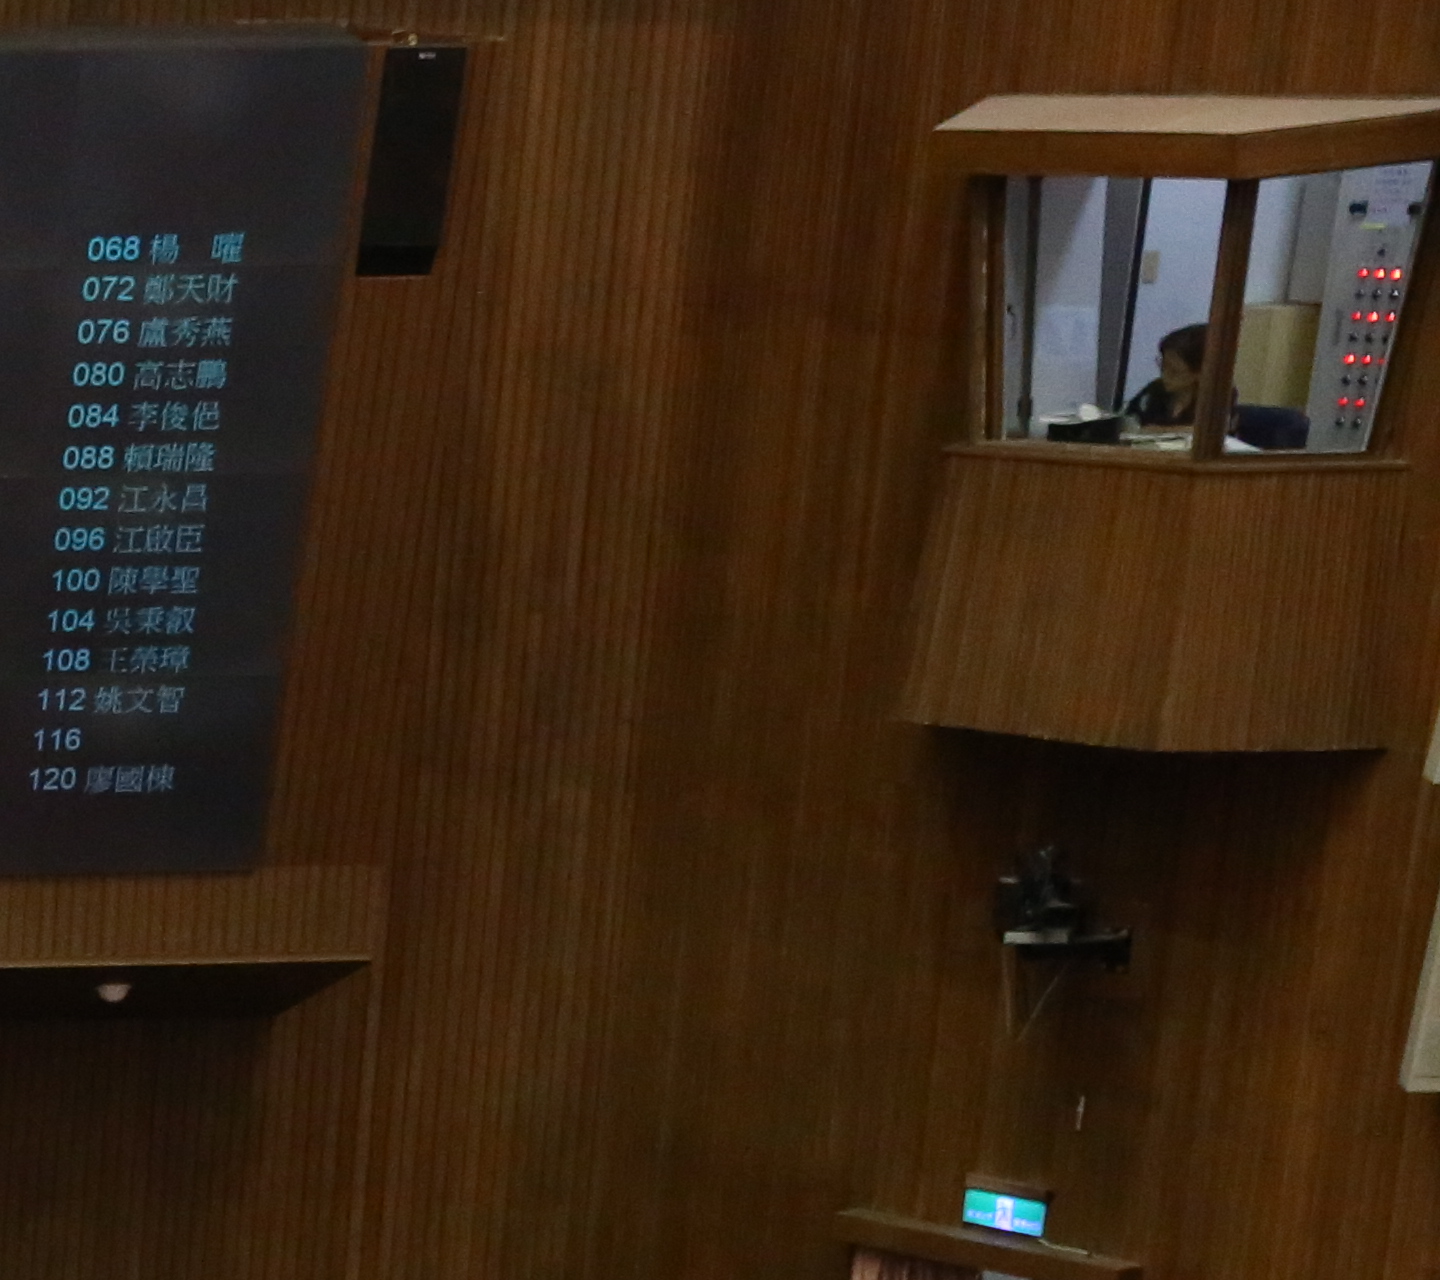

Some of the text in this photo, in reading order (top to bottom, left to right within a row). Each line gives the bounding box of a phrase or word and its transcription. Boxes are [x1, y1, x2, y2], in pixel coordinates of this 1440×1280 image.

[86, 234, 142, 263] 068
[81, 275, 136, 302] 072
[76, 318, 131, 345] 076
[71, 361, 126, 388] 080
[67, 402, 121, 429] 084
[61, 444, 116, 471] 088
[57, 483, 208, 513] 092 江永昌
[53, 526, 106, 552] 096
[52, 567, 102, 592] 100
[47, 608, 96, 633] 104
[42, 647, 91, 672] 108
[37, 687, 87, 712] 112
[33, 727, 82, 752] 116
[28, 766, 77, 791] 120
